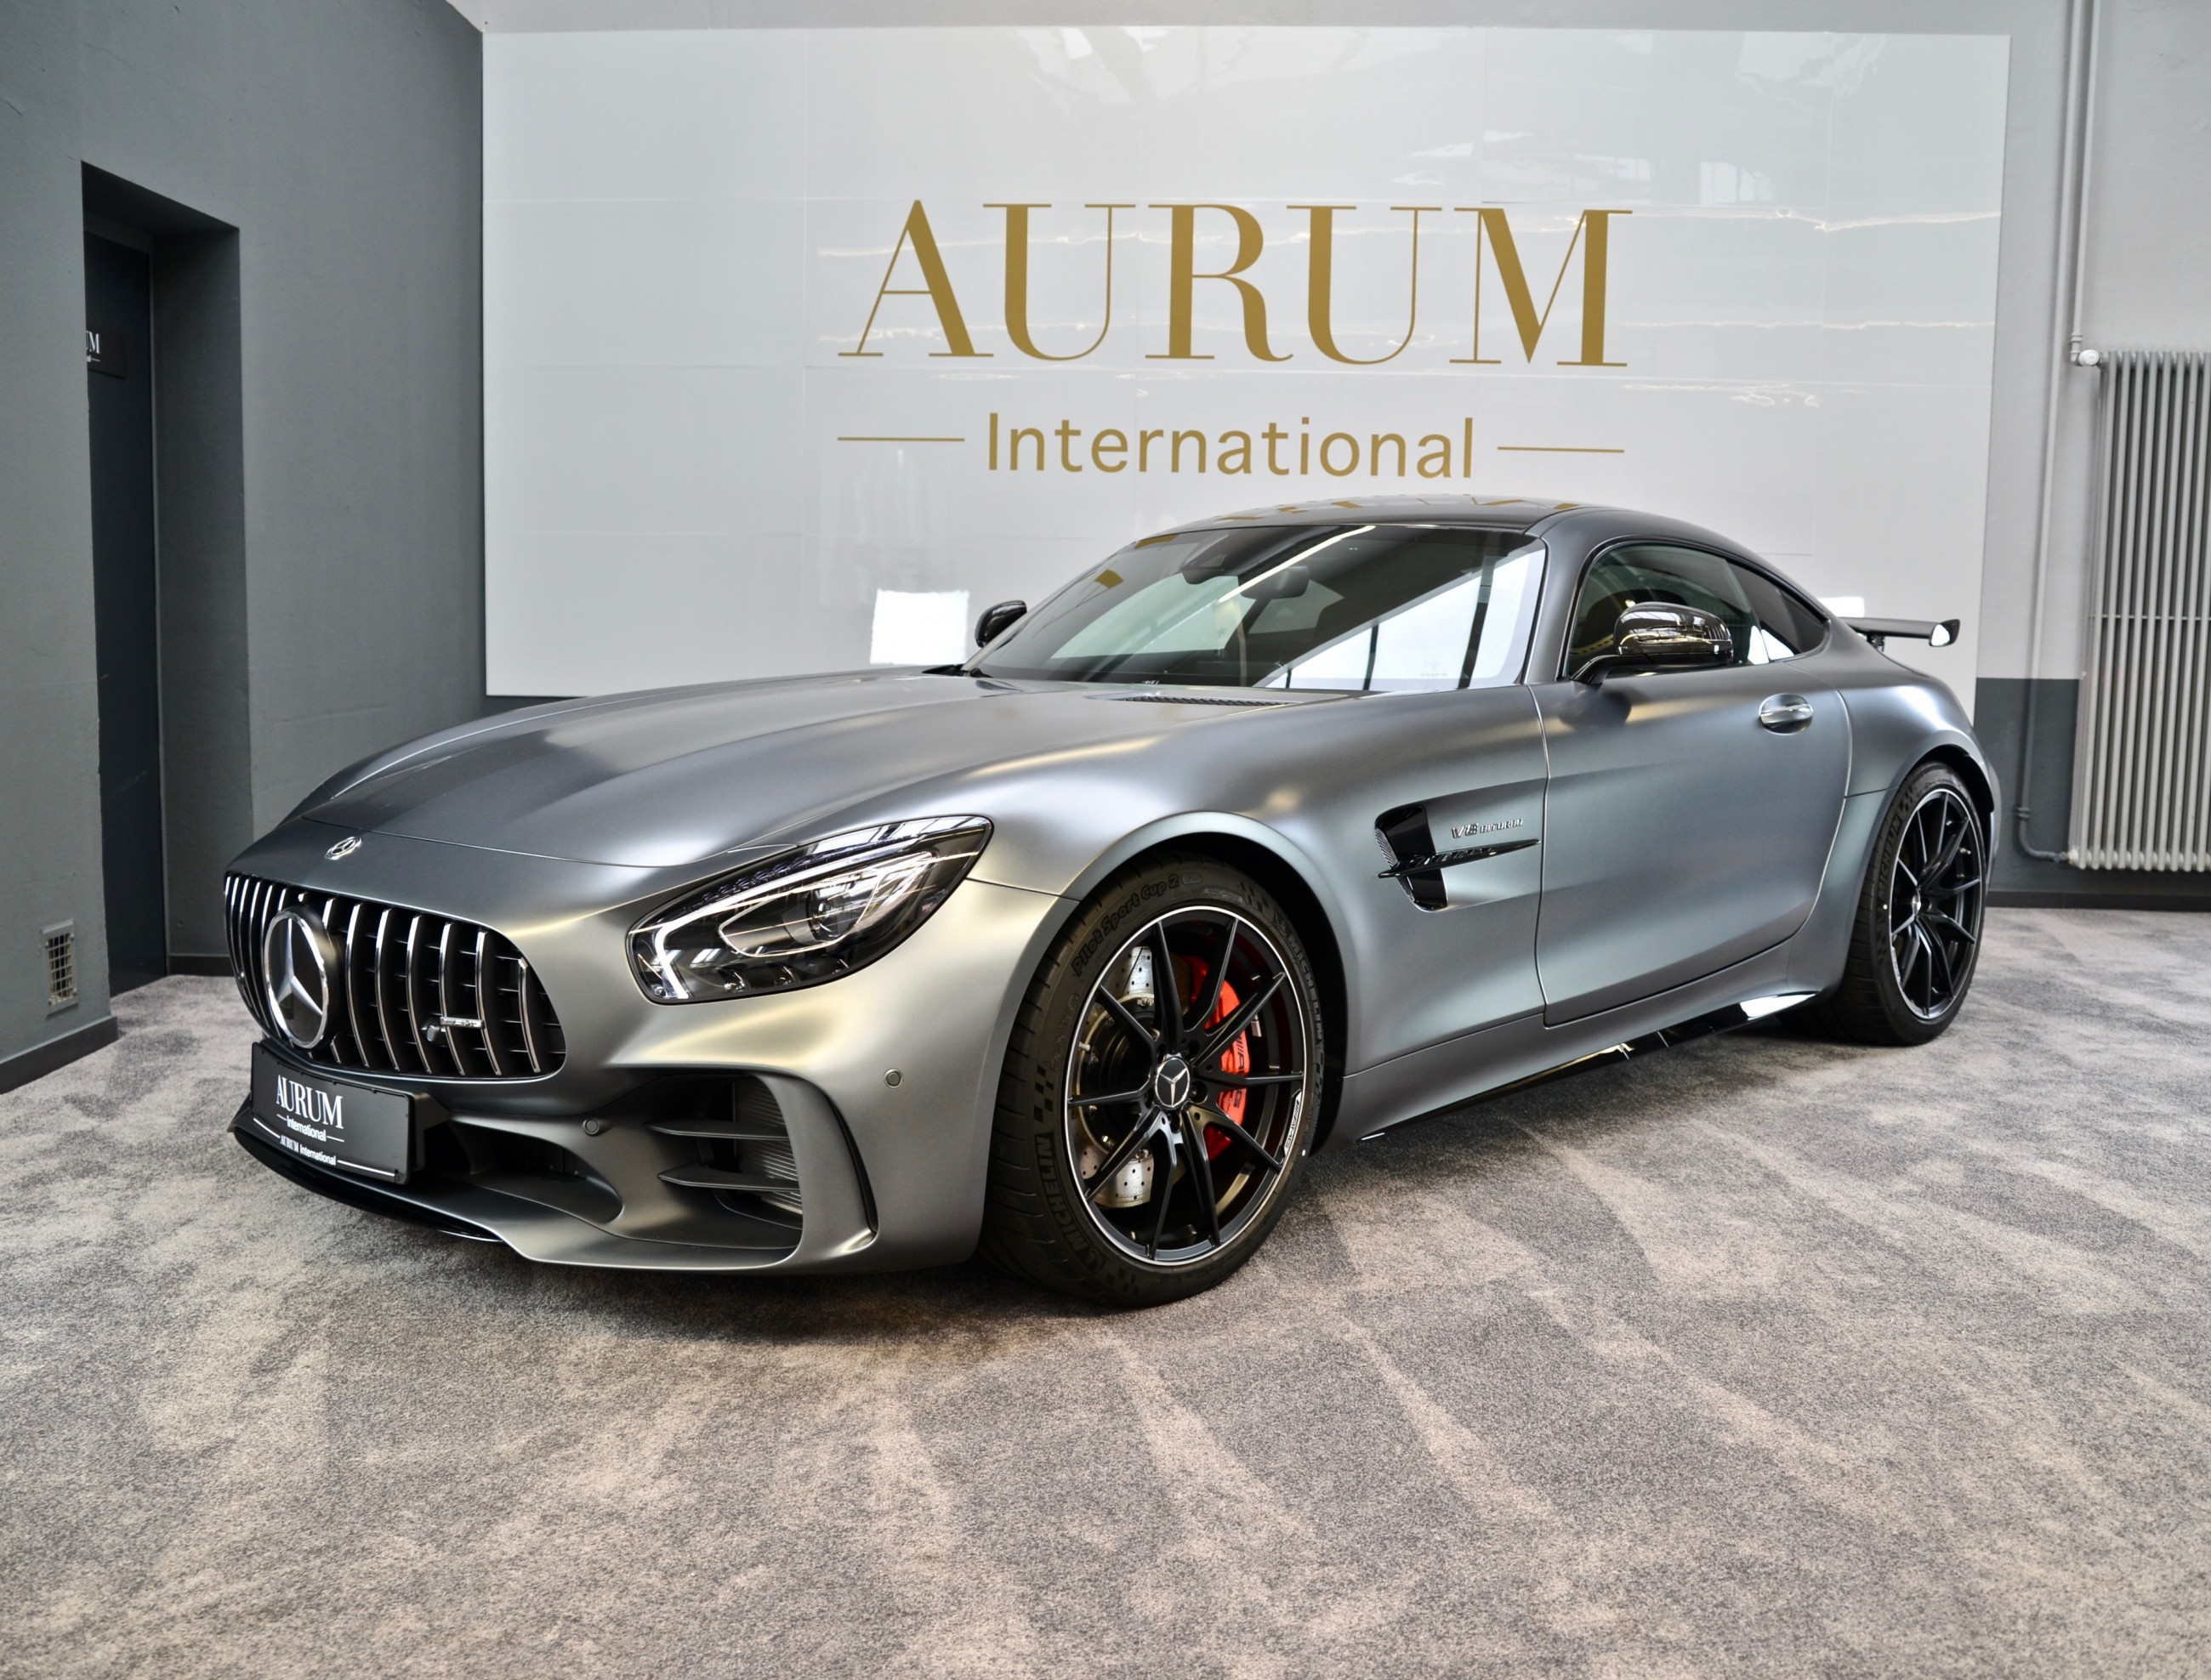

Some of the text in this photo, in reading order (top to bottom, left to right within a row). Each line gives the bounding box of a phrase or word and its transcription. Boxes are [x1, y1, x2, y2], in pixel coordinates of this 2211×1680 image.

[838, 199, 1633, 367] AURUM
[988, 412, 1474, 479] International
[1452, 822, 1478, 838] V8
[1878, 814, 1903, 899] MICHELIN
[1071, 927, 1105, 978] Pilot
[1101, 893, 1140, 936] Sport
[1140, 882, 1168, 901] Cup
[1168, 872, 1180, 890] 2
[1287, 934, 1323, 1052] MICHELIN
[276, 1074, 345, 1130] AURUM
[286, 1115, 327, 1142] International
[299, 1144, 337, 1166] International
[1035, 1133, 1090, 1253] MICHELIN
